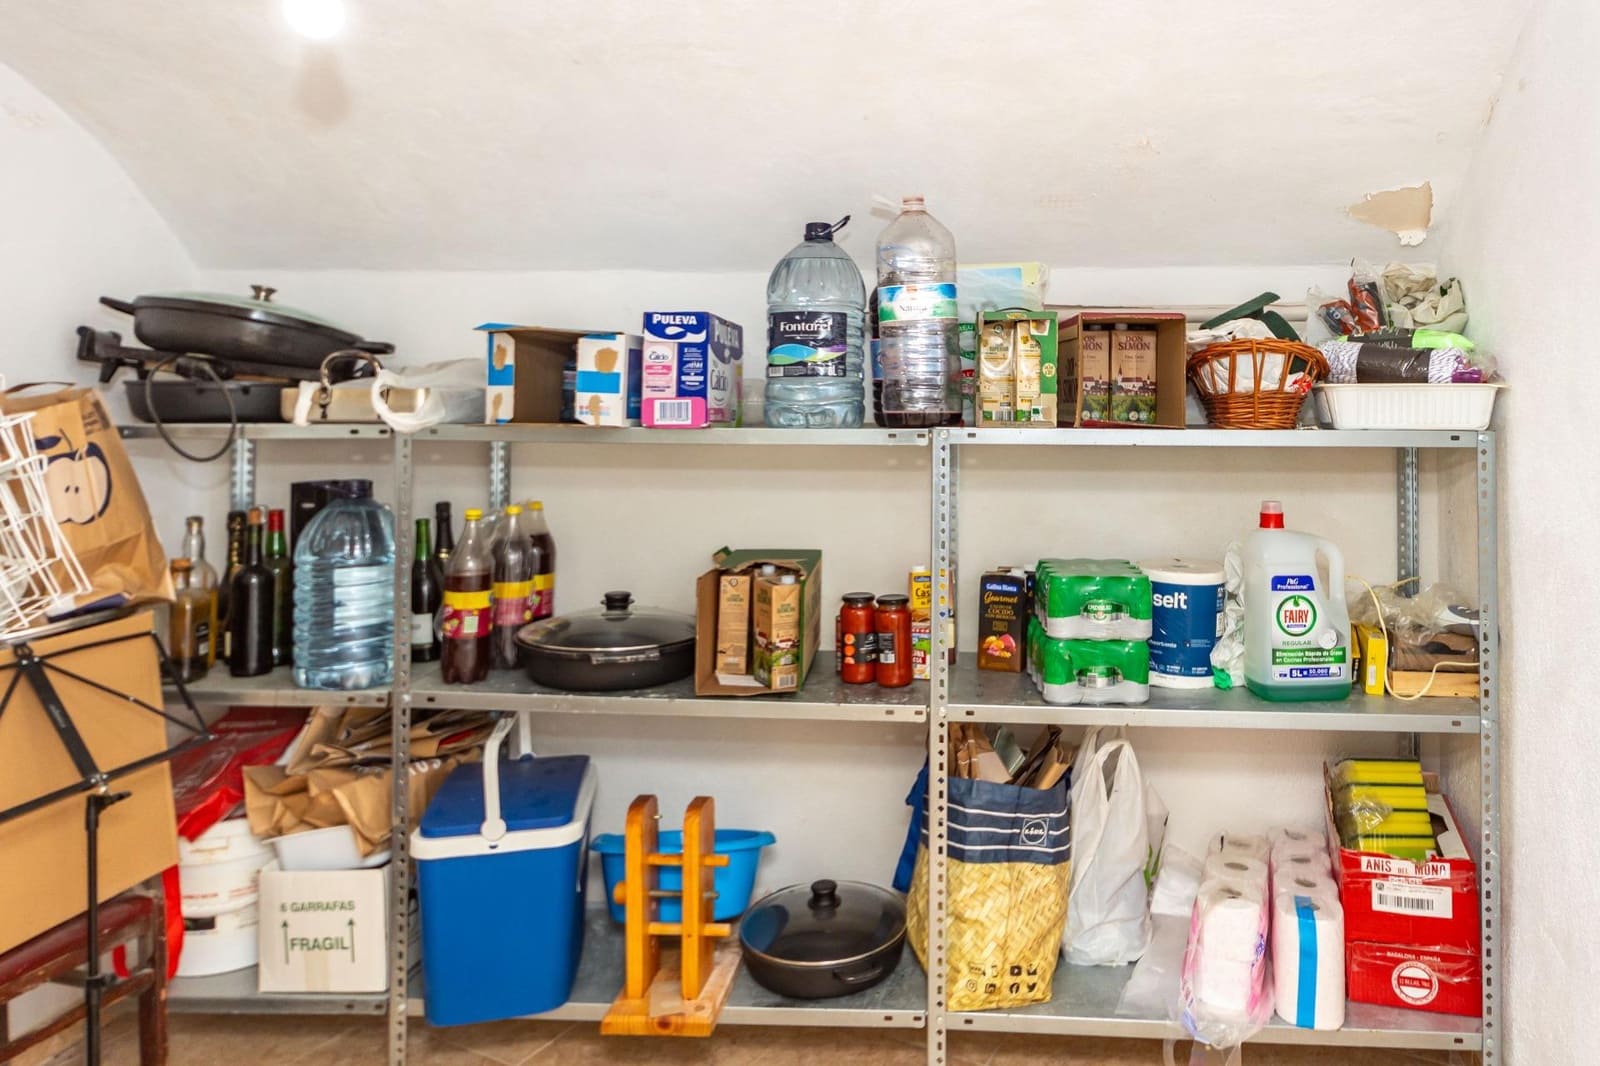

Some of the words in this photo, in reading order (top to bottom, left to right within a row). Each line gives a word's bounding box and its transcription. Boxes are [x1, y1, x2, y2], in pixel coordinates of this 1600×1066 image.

[652, 314, 697, 325] PULEVA
[984, 591, 1018, 604] Gourmet
[1152, 592, 1188, 610] selt
[1284, 609, 1309, 624] FAIRY
[290, 900, 355, 912] GARRAFAS
[289, 937, 349, 951] FRAGIL
